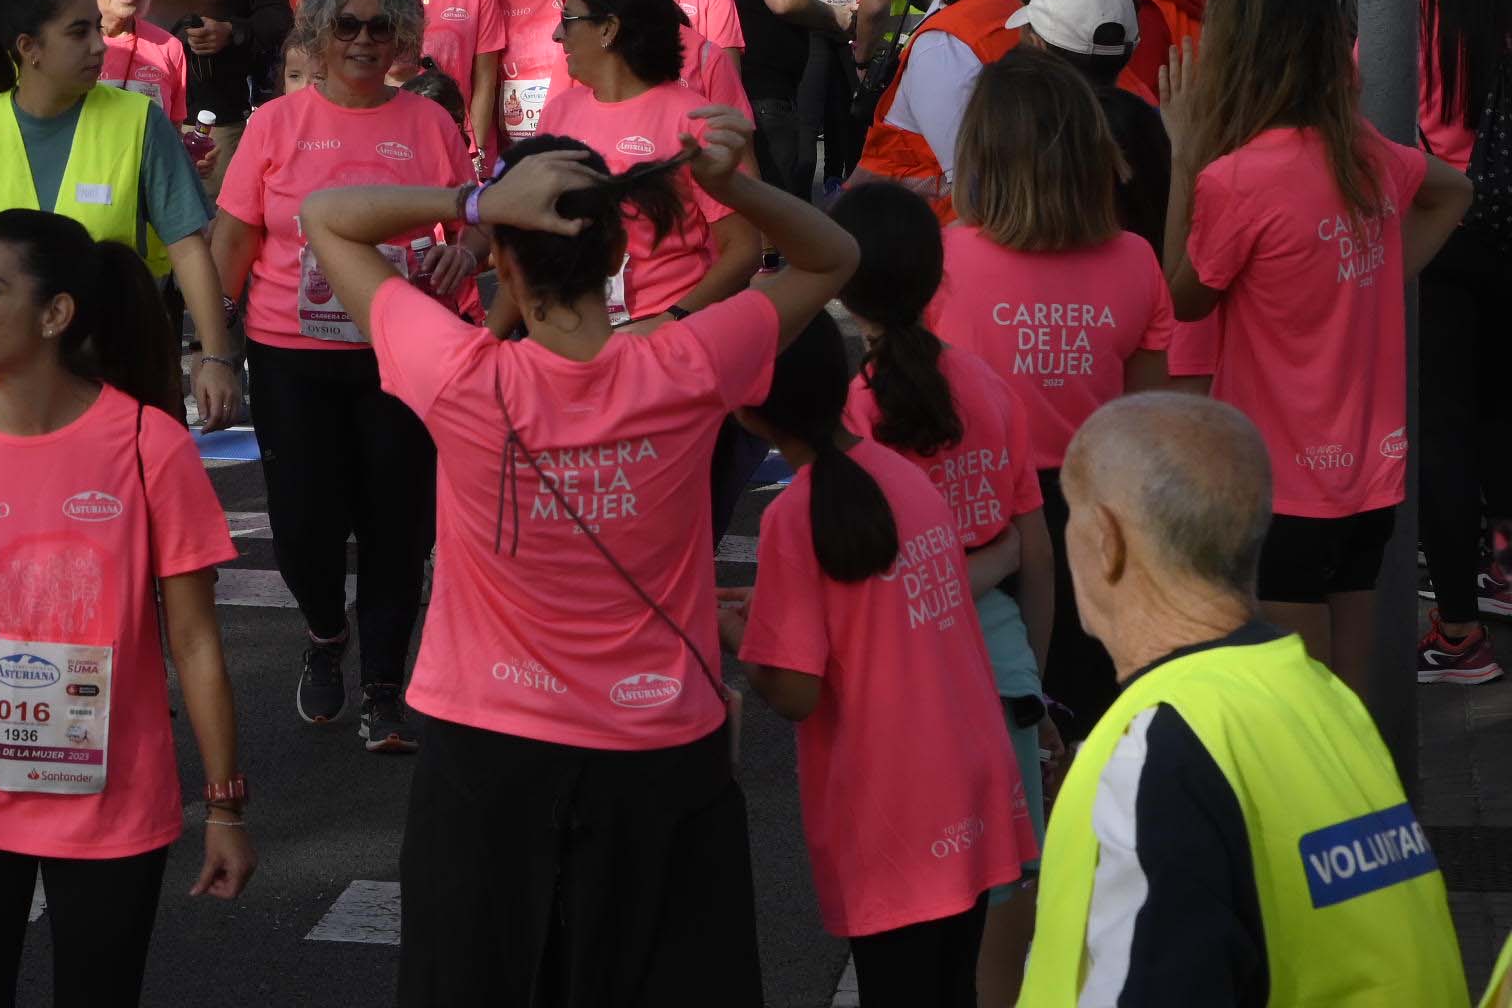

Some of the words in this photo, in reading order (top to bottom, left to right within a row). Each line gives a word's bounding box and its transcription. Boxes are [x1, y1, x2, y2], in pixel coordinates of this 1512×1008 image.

[296, 138, 341, 152] OYSHO
[1336, 247, 1385, 283] MUJER
[309, 312, 337, 321] CARRERA
[992, 303, 1116, 327] CARRERA
[1018, 328, 1050, 351] DE
[1061, 328, 1090, 351] LA
[1013, 352, 1094, 376] MUJER
[1042, 378, 1065, 388] 2023
[593, 466, 631, 492] LA
[964, 476, 996, 504] LA
[67, 502, 119, 514] ASTURIANA
[903, 567, 931, 599] DE
[931, 558, 956, 585] LA
[67, 663, 100, 675] SUMA
[617, 685, 677, 702] ASTURIANA
[4, 728, 38, 742] 1936
[2, 748, 15, 757] DE
[17, 748, 29, 758] LA
[30, 749, 65, 760] MUJER
[68, 751, 89, 761] 2023
[41, 769, 92, 783] Santander
